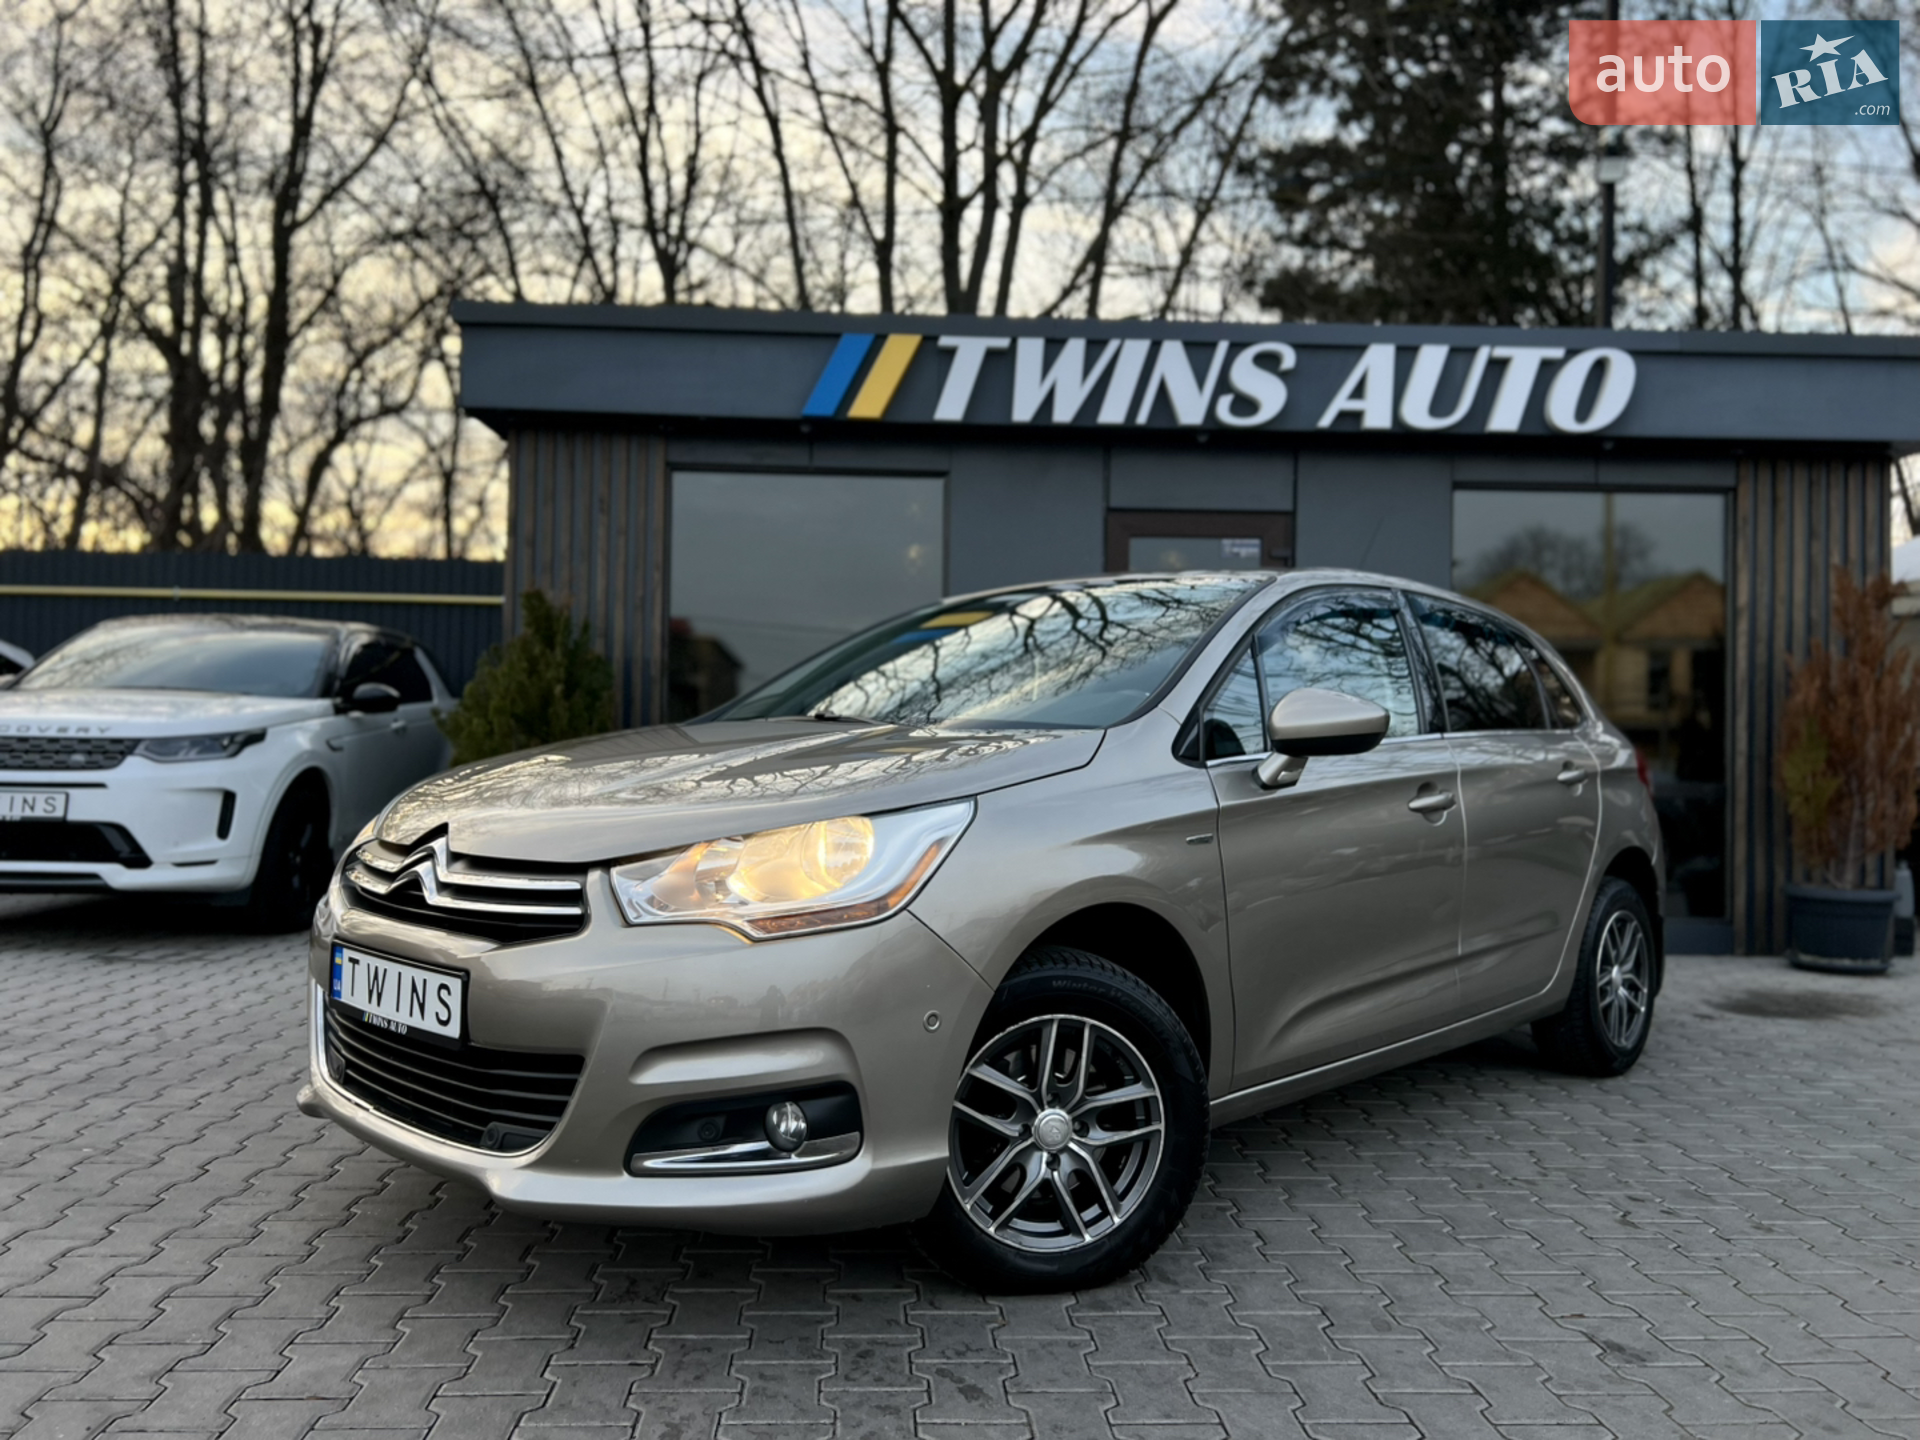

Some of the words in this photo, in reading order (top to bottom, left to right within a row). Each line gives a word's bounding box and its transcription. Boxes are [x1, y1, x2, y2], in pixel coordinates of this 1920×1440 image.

[932, 335, 1297, 429] TWINS
[1316, 341, 1638, 435] AUTO
[348, 956, 452, 1027] TWINS
